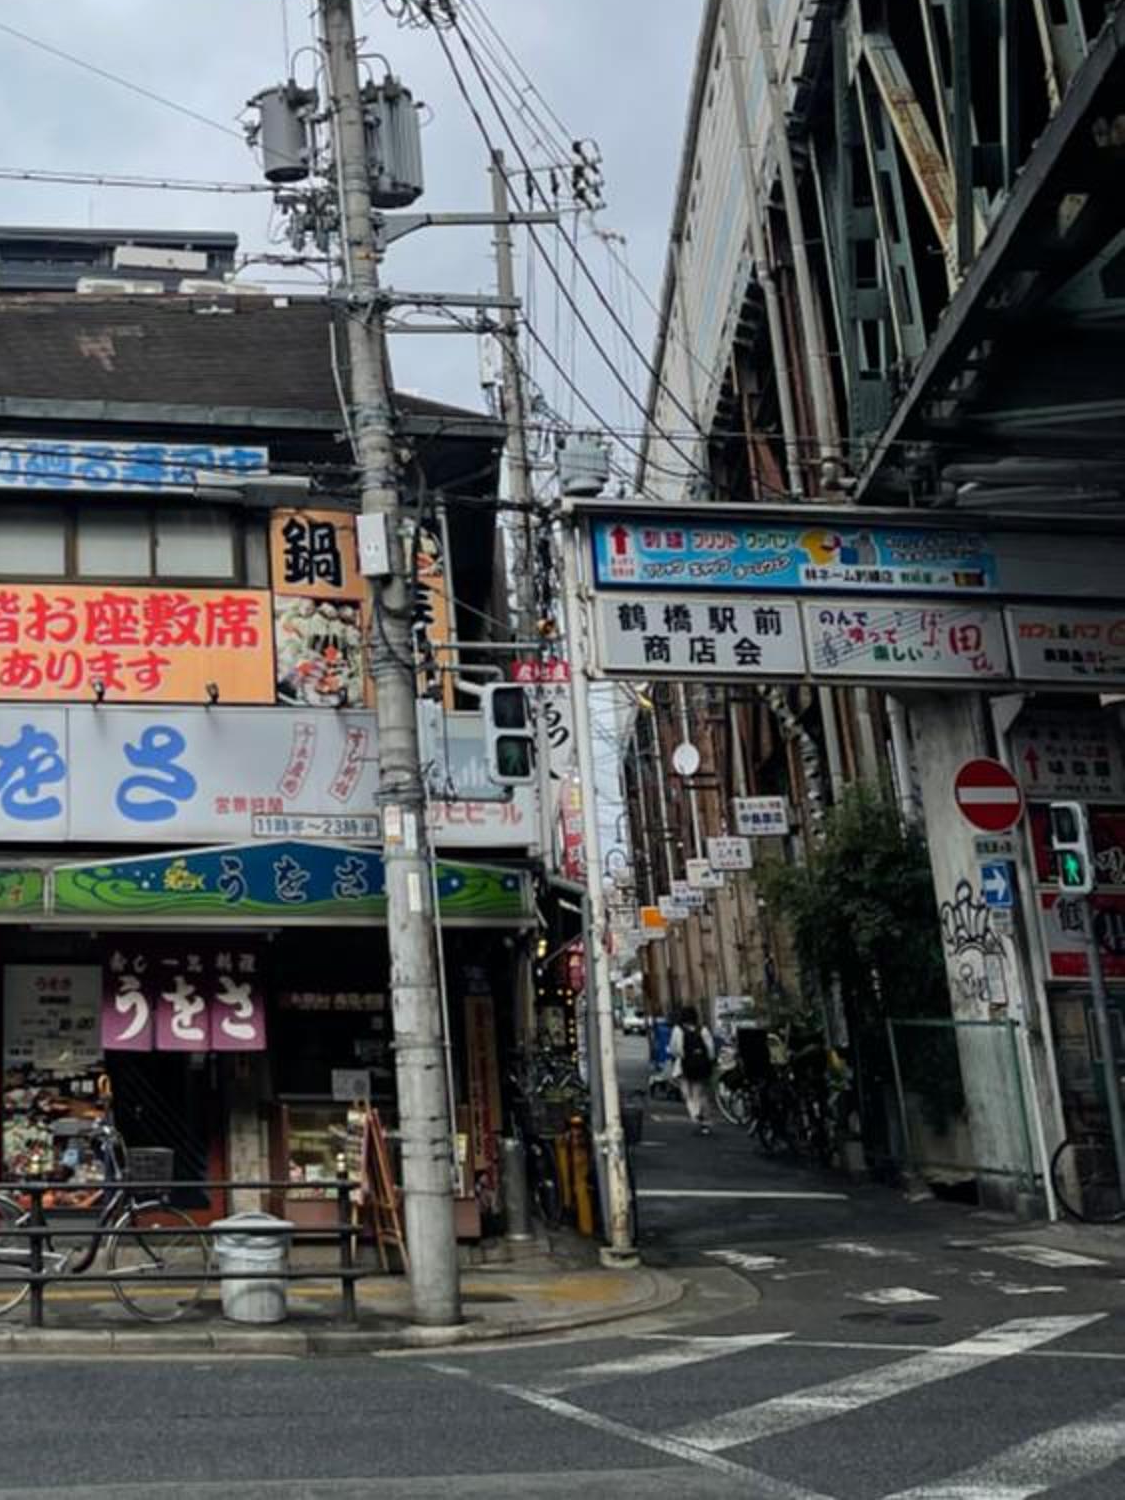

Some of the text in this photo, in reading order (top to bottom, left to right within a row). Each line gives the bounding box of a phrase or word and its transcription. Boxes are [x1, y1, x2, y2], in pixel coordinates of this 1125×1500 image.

[281, 518, 343, 590] 鍋
[616, 602, 784, 636] 鶴橋駅前
[819, 610, 867, 626] のんで
[643, 635, 763, 667] 商店会
[0, 650, 171, 693] あります
[114, 976, 257, 1044] うをさ
